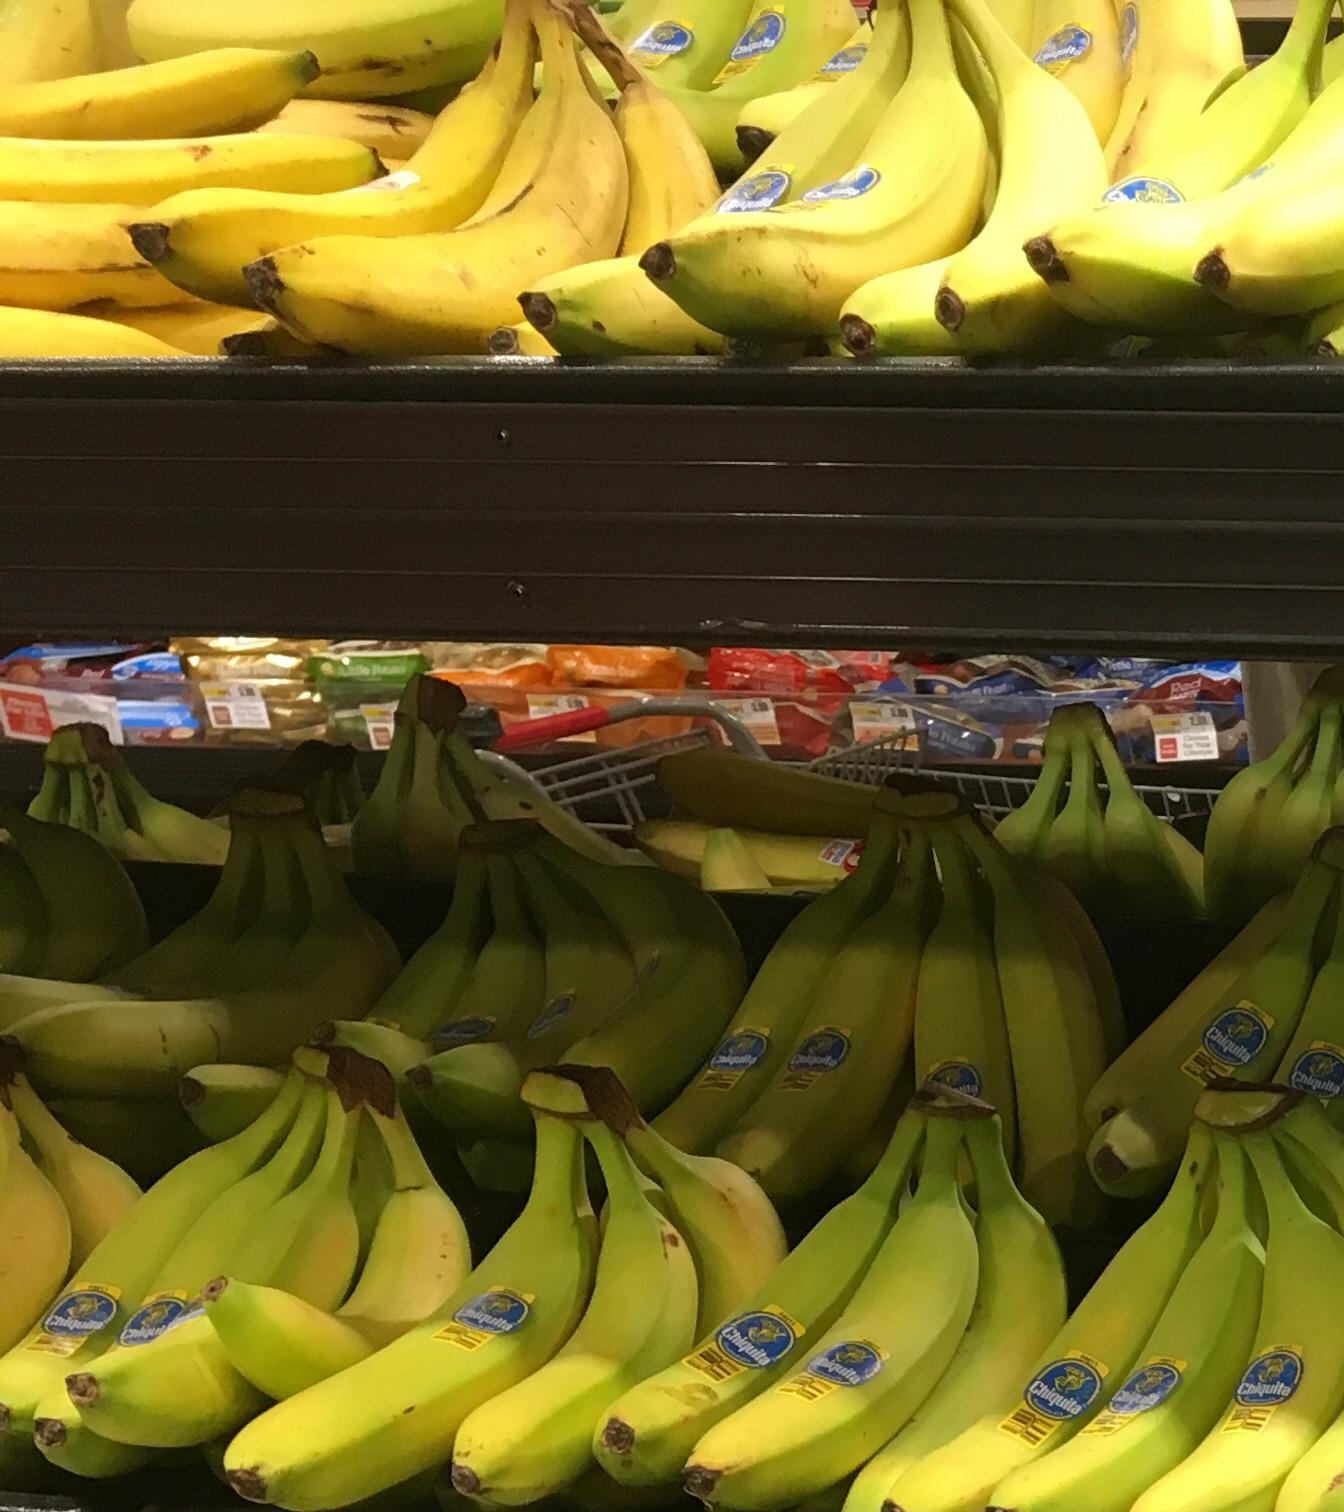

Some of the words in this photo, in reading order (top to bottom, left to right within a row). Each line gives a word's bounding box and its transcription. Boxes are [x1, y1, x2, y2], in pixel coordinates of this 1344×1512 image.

[1206, 1027, 1250, 1063] Chiquita
[1292, 1071, 1339, 1094] Chiquita
[721, 1327, 770, 1366] Chiquita
[1030, 1380, 1081, 1415] Chiquita
[1237, 1383, 1291, 1397] Chiquita
